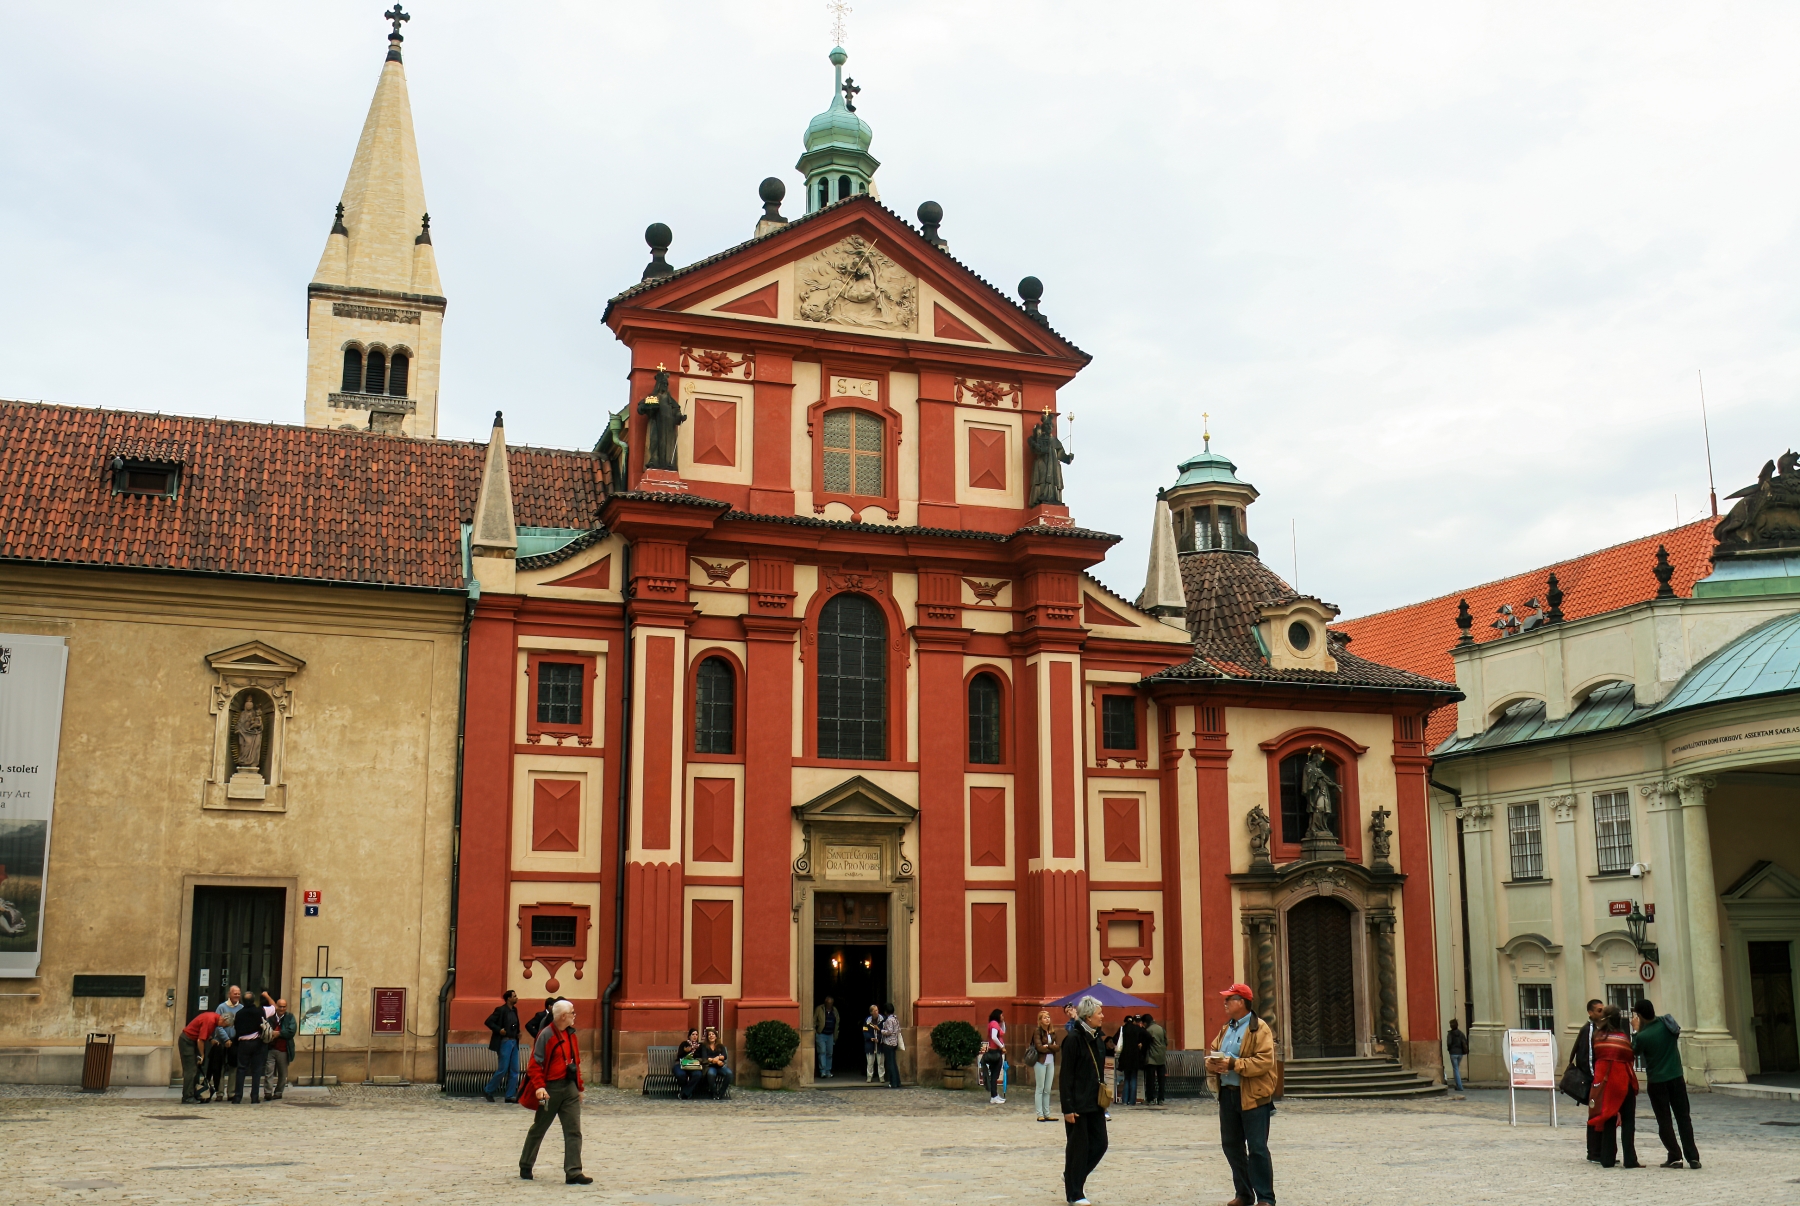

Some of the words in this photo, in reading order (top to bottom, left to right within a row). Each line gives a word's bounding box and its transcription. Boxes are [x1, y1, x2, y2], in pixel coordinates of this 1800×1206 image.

[1744, 729, 1774, 739] ASSERTAM
[7, 764, 39, 773] století
[15, 790, 30, 798] Art
[826, 860, 843, 870] ORA
[844, 860, 859, 870] PRO
